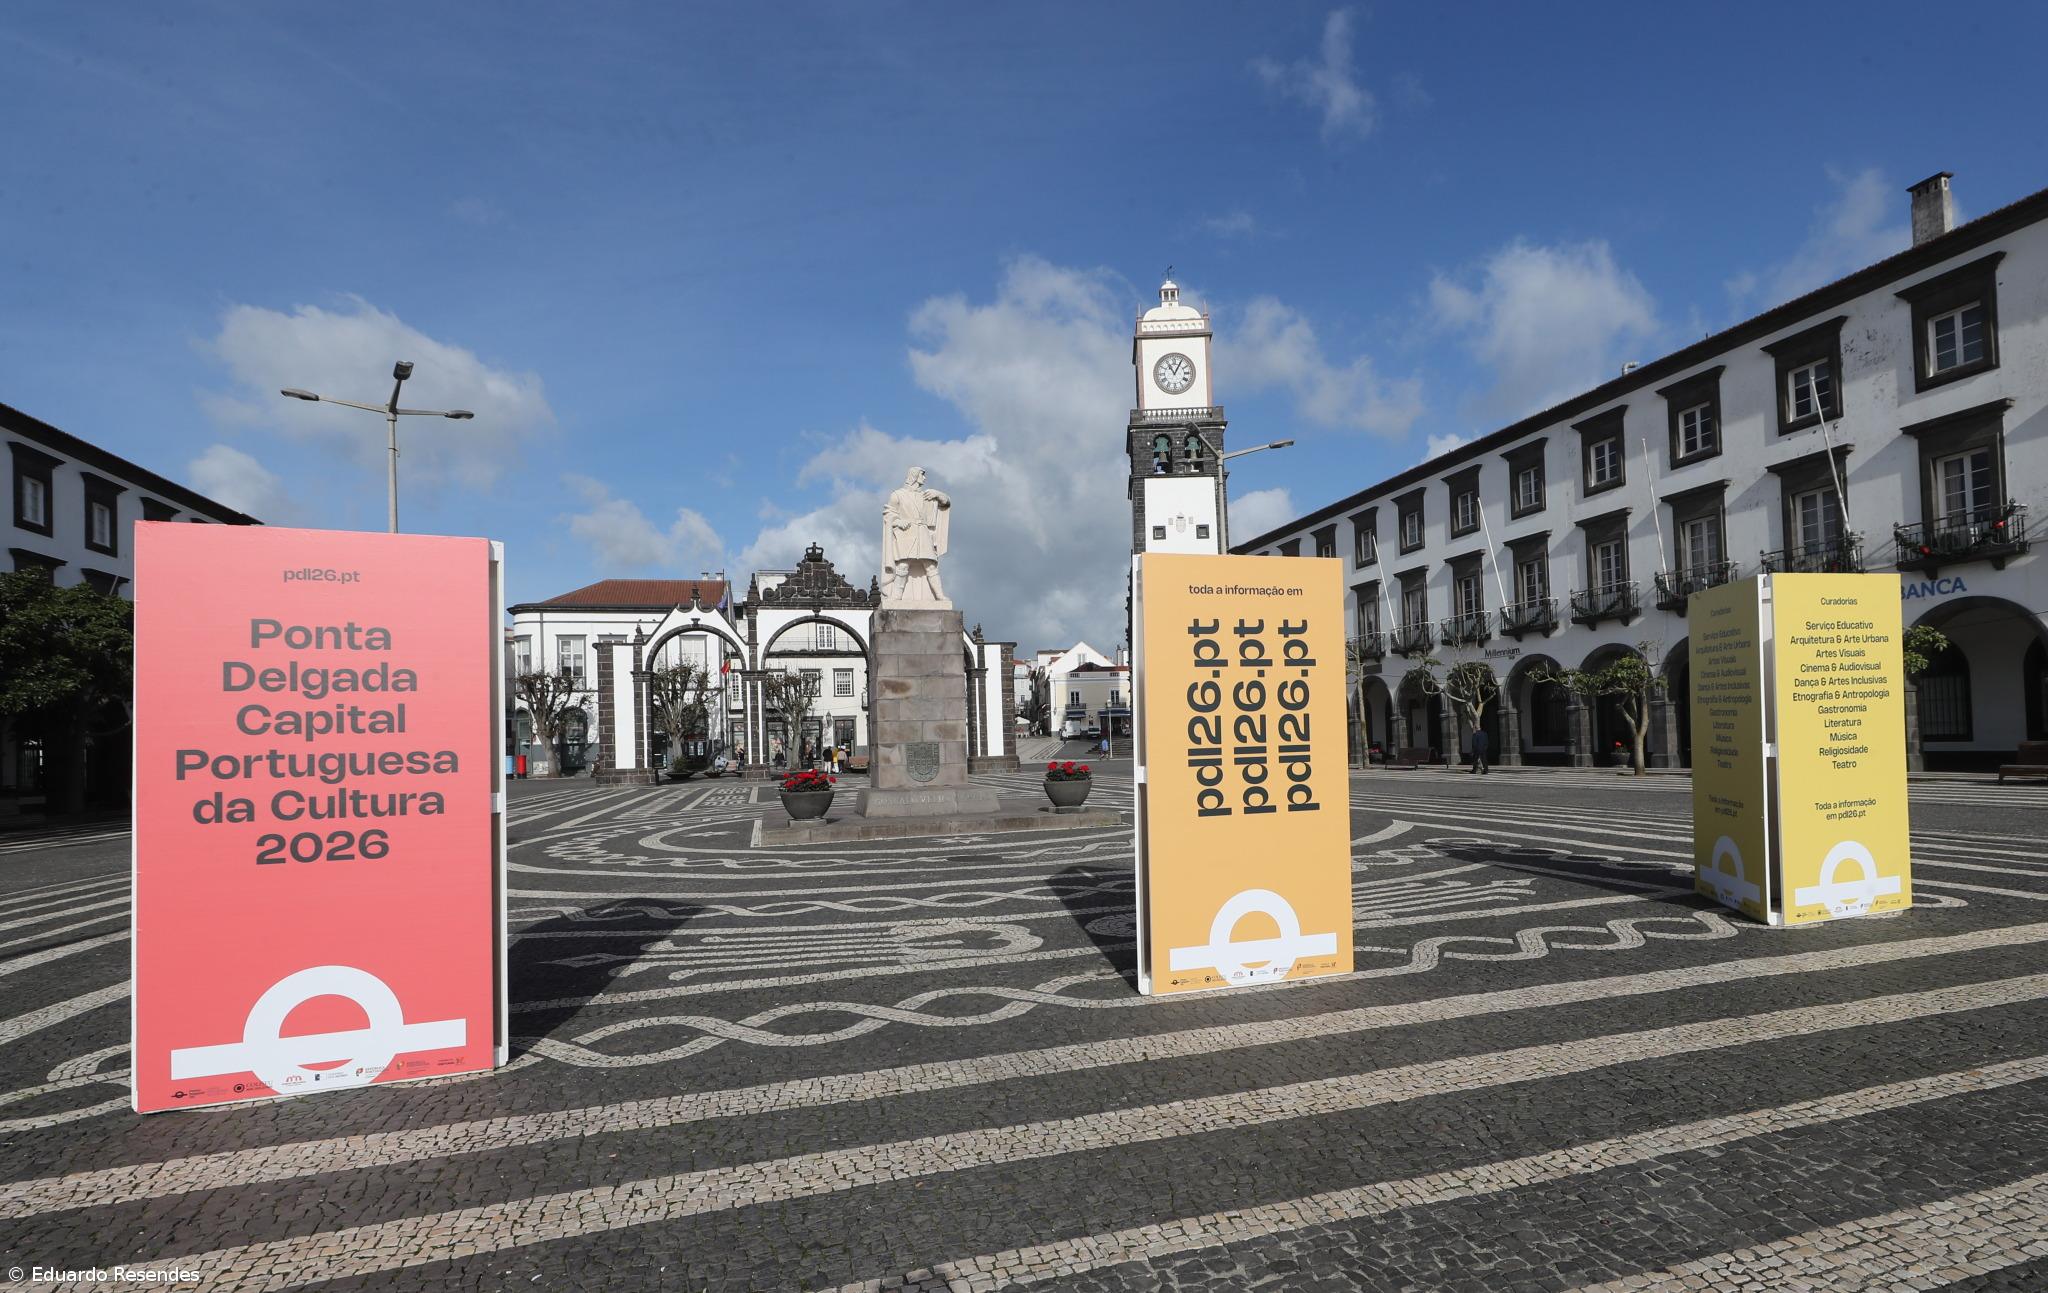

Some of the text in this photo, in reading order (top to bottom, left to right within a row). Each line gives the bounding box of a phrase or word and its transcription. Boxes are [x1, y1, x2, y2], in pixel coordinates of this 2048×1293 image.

[284, 568, 361, 585] pdl26.pt
[1189, 584, 1303, 598] toda a informação em
[1820, 598, 1858, 606] Curadorias
[1806, 620, 1873, 631] Serviço Educativo
[250, 618, 392, 650] Ponta
[1790, 635, 1834, 646] Arquitetura
[1844, 635, 1860, 643] Arte
[1862, 634, 1889, 643] Urbana
[1485, 648, 1520, 658] Millennium
[1816, 648, 1865, 658] Artes Visuais
[1800, 664, 1829, 672] Cinema
[1839, 662, 1881, 671] Audiovisual
[223, 661, 417, 700] Delgada
[1795, 678, 1819, 688] Dança
[1828, 677, 1850, 685] Artes
[1851, 676, 1887, 684] Inclusivas
[1793, 691, 1833, 702] Etnografia
[1842, 689, 1890, 700] Antropologia
[1278, 618, 1320, 812] pdl26.pt
[1818, 704, 1867, 714] Gastronomia
[1187, 618, 1232, 817] pdl26.pt
[1233, 618, 1276, 814] pdl26.pt
[236, 703, 406, 742] Capital
[1824, 719, 1862, 728] Literatura
[1830, 732, 1857, 741] Música
[1819, 745, 1868, 757] Religiosidade
[176, 749, 458, 784] Portuguesa
[1832, 760, 1857, 769] Teatro
[192, 787, 445, 824] da Cultura
[1815, 802, 1831, 810] Toda
[1839, 798, 1876, 808] informação
[1839, 809, 1866, 821] pdl26.pt
[256, 829, 389, 865] 2026
